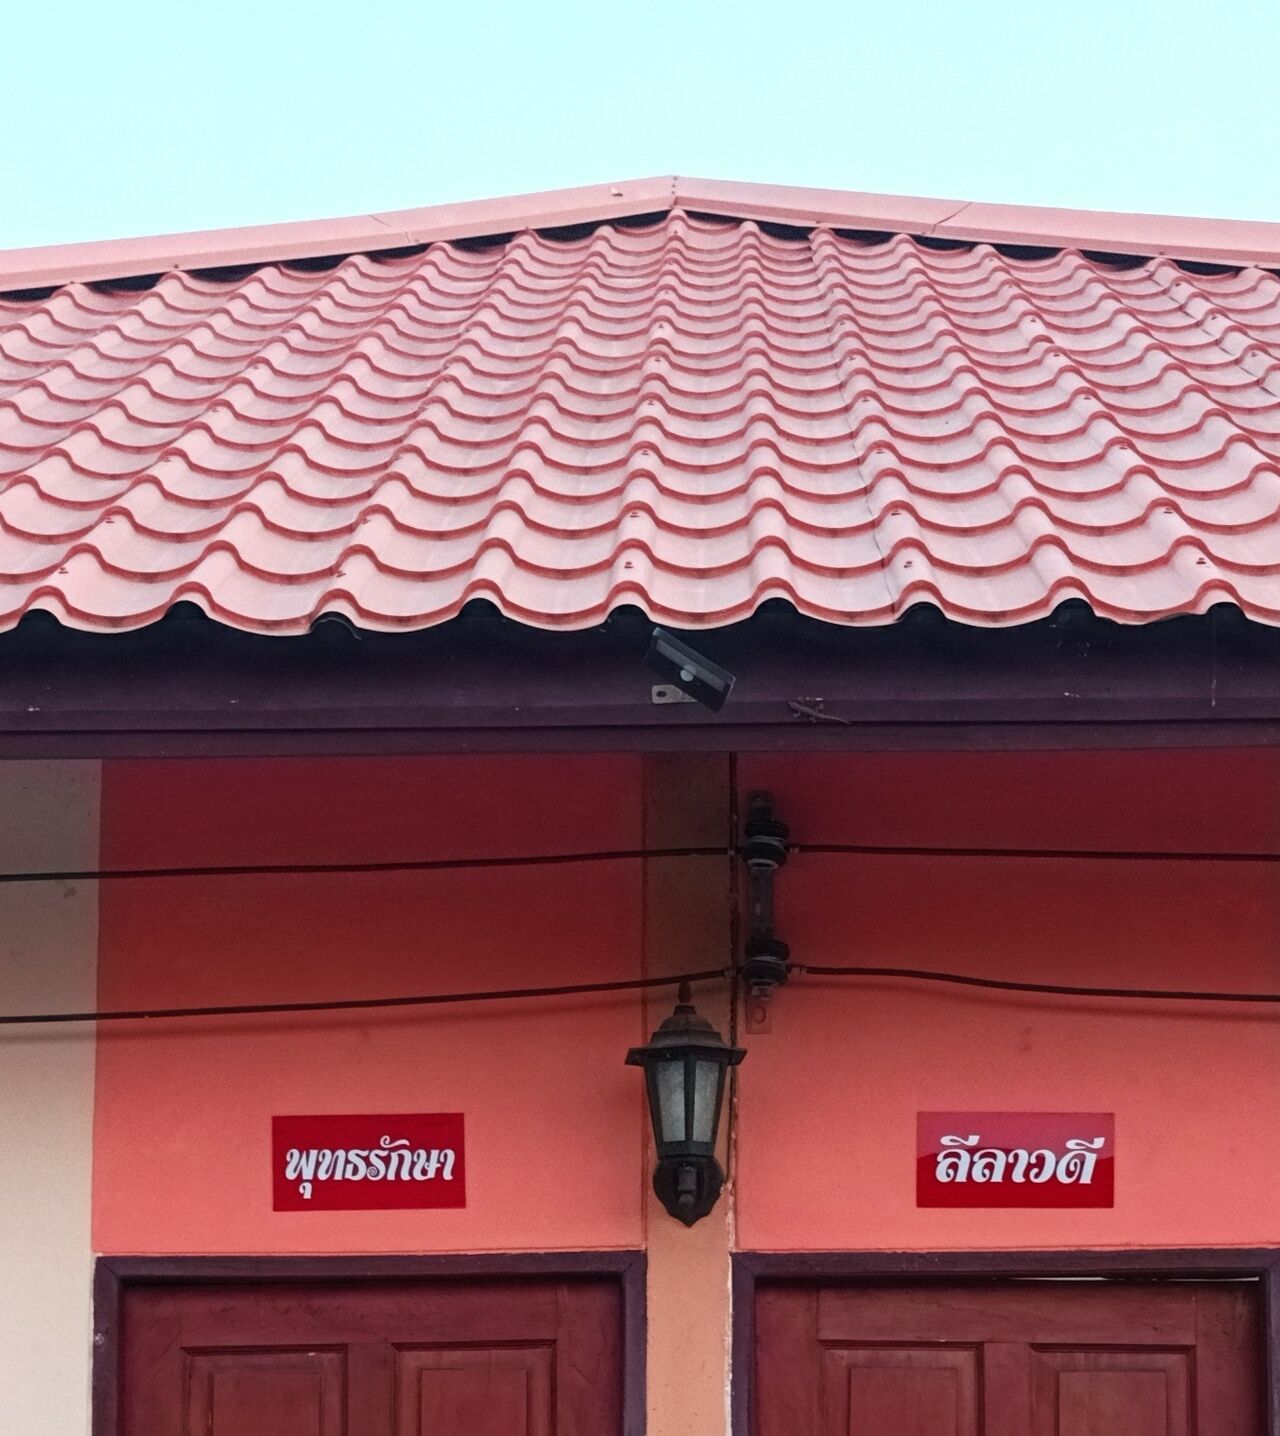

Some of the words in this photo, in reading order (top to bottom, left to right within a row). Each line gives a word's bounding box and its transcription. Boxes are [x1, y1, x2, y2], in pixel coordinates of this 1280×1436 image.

[285, 1135, 455, 1199] พุทธรักษา
[935, 1135, 1105, 1184] ลีลาวดี
